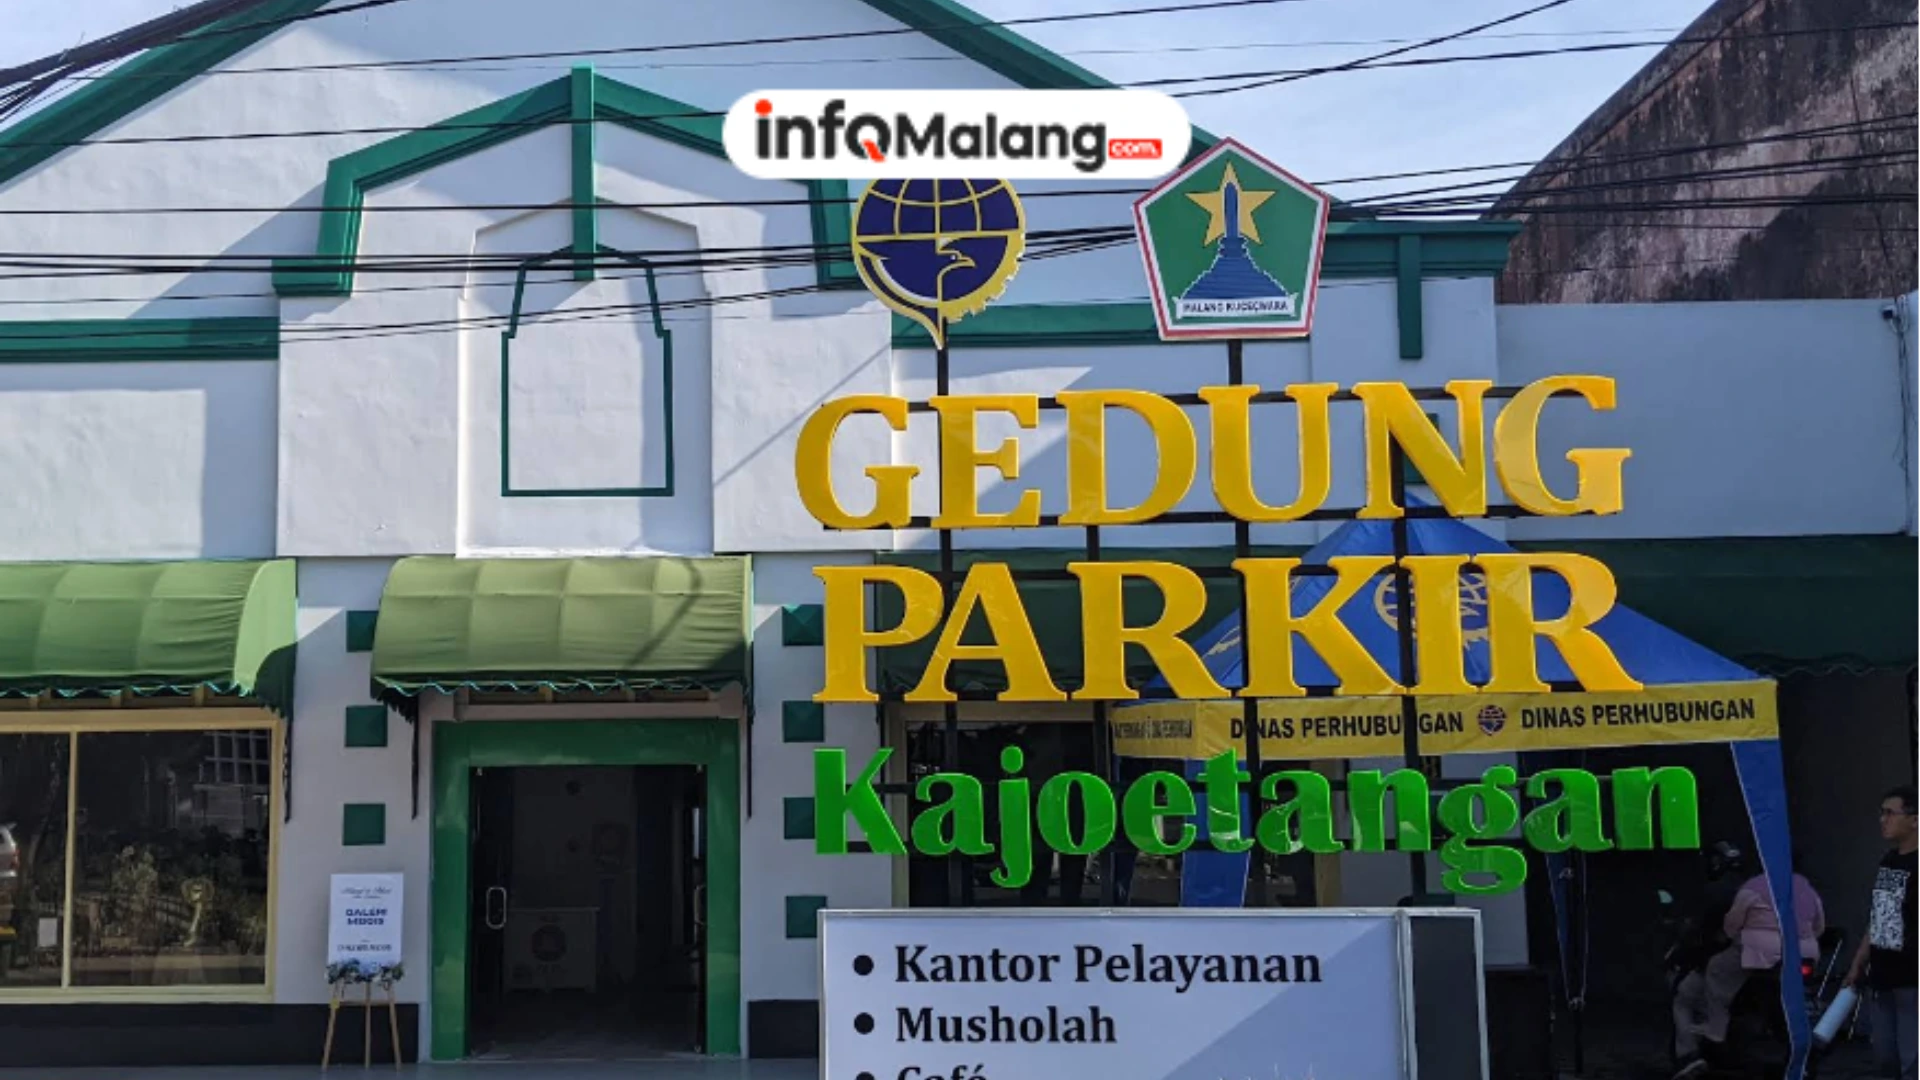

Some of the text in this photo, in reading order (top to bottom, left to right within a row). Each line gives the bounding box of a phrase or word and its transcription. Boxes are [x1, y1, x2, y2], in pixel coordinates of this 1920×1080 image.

[795, 375, 1631, 529] GEDUNG
[813, 552, 1644, 703] PARKIR
[1230, 711, 1464, 739] DNAS PERHUBUGAN
[1521, 698, 1755, 730] DINAS PERHUBUNGAN
[813, 746, 1700, 896] Kajoetangan
[894, 944, 1323, 994] Kantor Pelayanan
[895, 1006, 1118, 1043] Musholah
